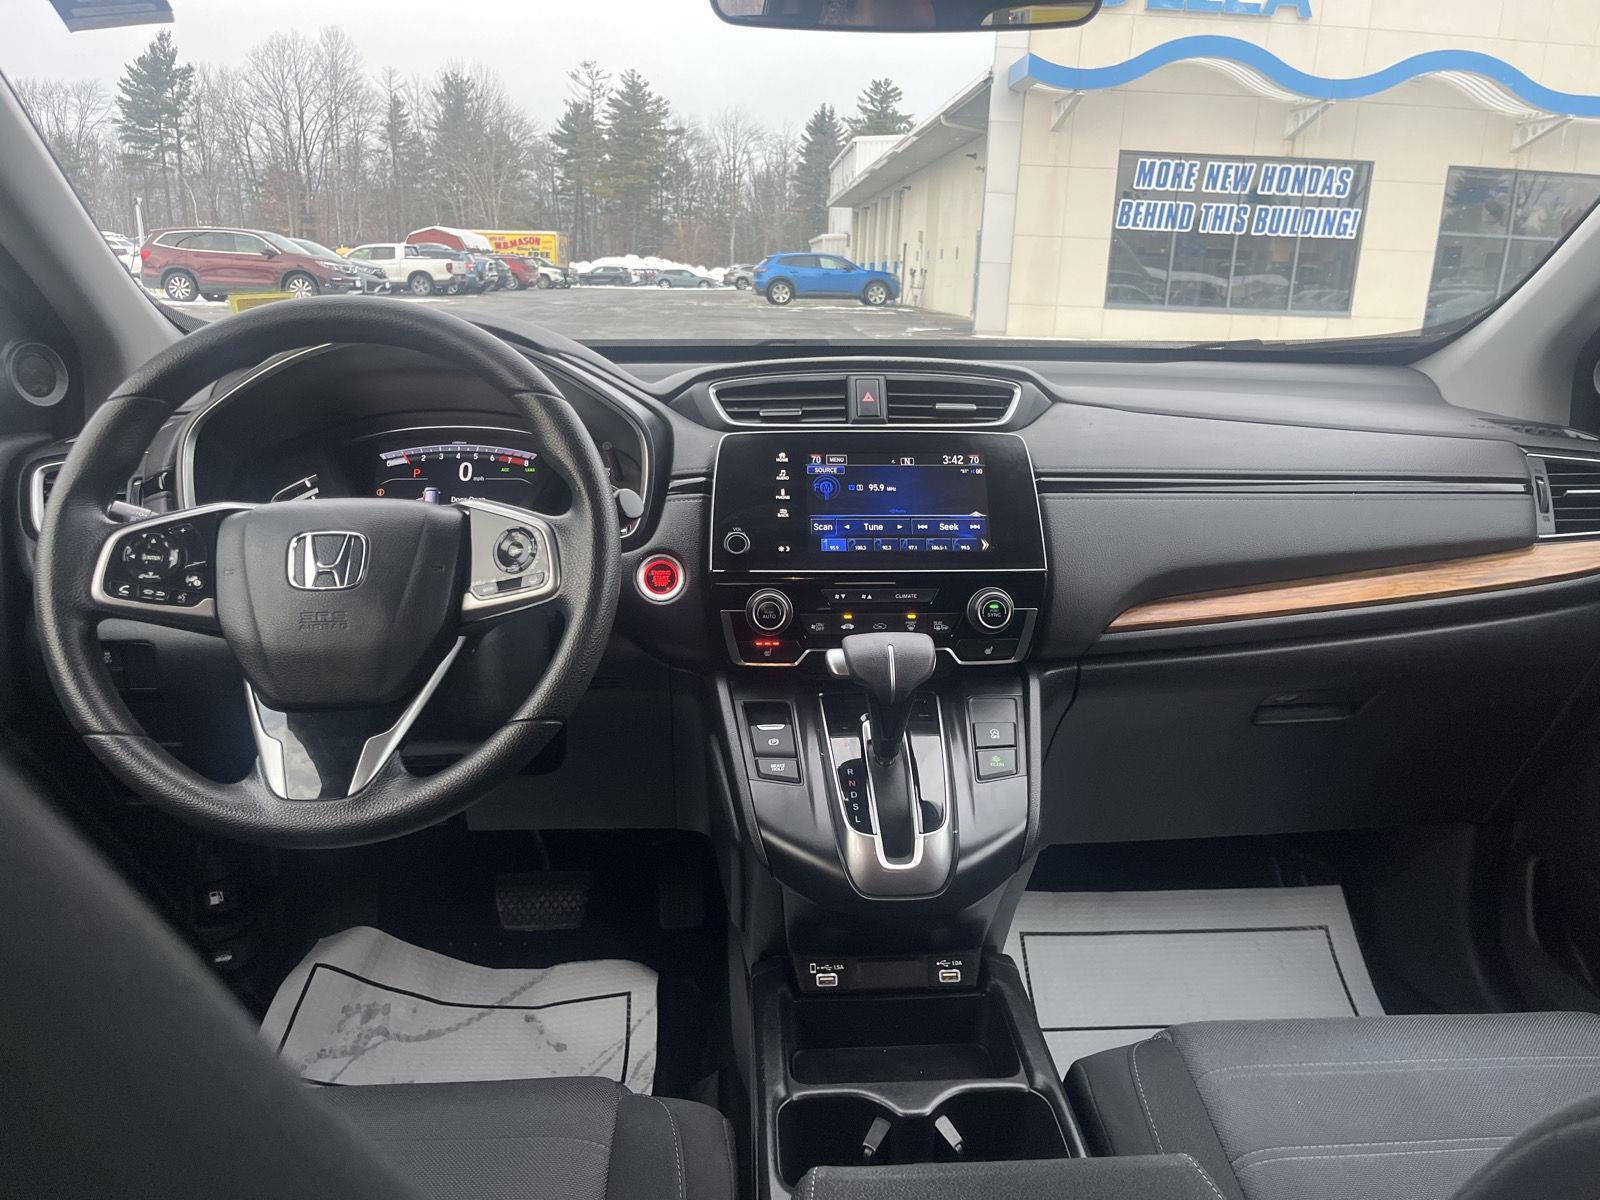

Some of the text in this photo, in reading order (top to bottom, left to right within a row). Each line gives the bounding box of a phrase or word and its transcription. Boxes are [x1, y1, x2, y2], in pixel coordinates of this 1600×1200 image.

[1134, 159, 1353, 198] MORE NEW HONDAS
[1116, 199, 1362, 239] BEHIND THIS BUILDING!
[811, 455, 822, 464] 70
[942, 455, 964, 465] 3:42
[969, 456, 980, 464] 70
[413, 468, 421, 478] P
[458, 462, 473, 482] 0
[868, 484, 885, 492] 95.9
[813, 523, 833, 531] Scan
[863, 523, 884, 531] Tune
[939, 523, 959, 531] Seek
[850, 791, 858, 799] D
[852, 803, 859, 811] S
[855, 815, 861, 823] L
